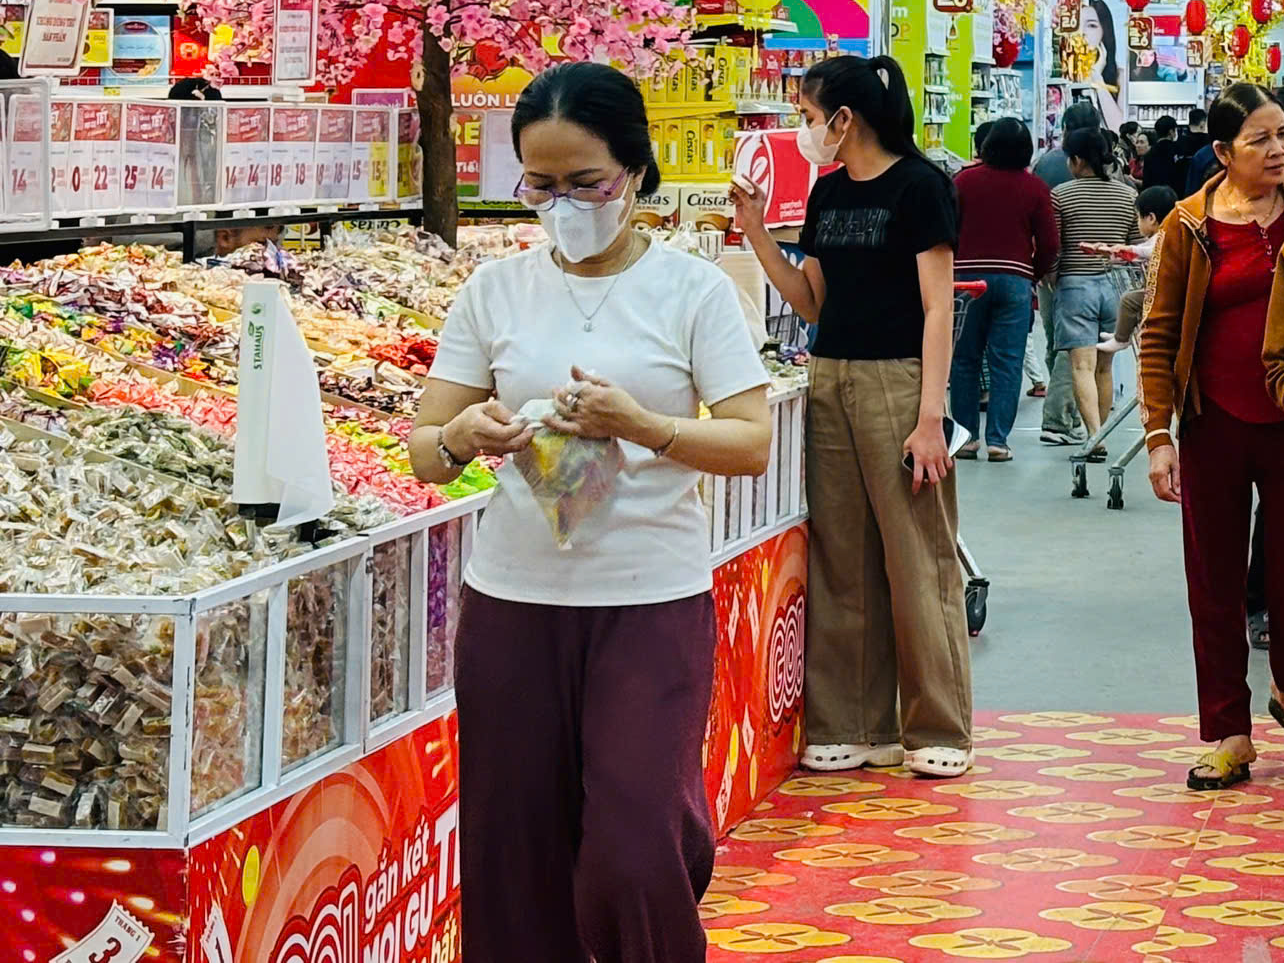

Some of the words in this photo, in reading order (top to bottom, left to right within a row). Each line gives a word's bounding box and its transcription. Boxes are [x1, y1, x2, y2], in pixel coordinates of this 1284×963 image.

[451, 91, 500, 107] LUÔN
[365, 848, 398, 933] gắn
[402, 815, 430, 887] kết
[404, 873, 435, 952] GU
